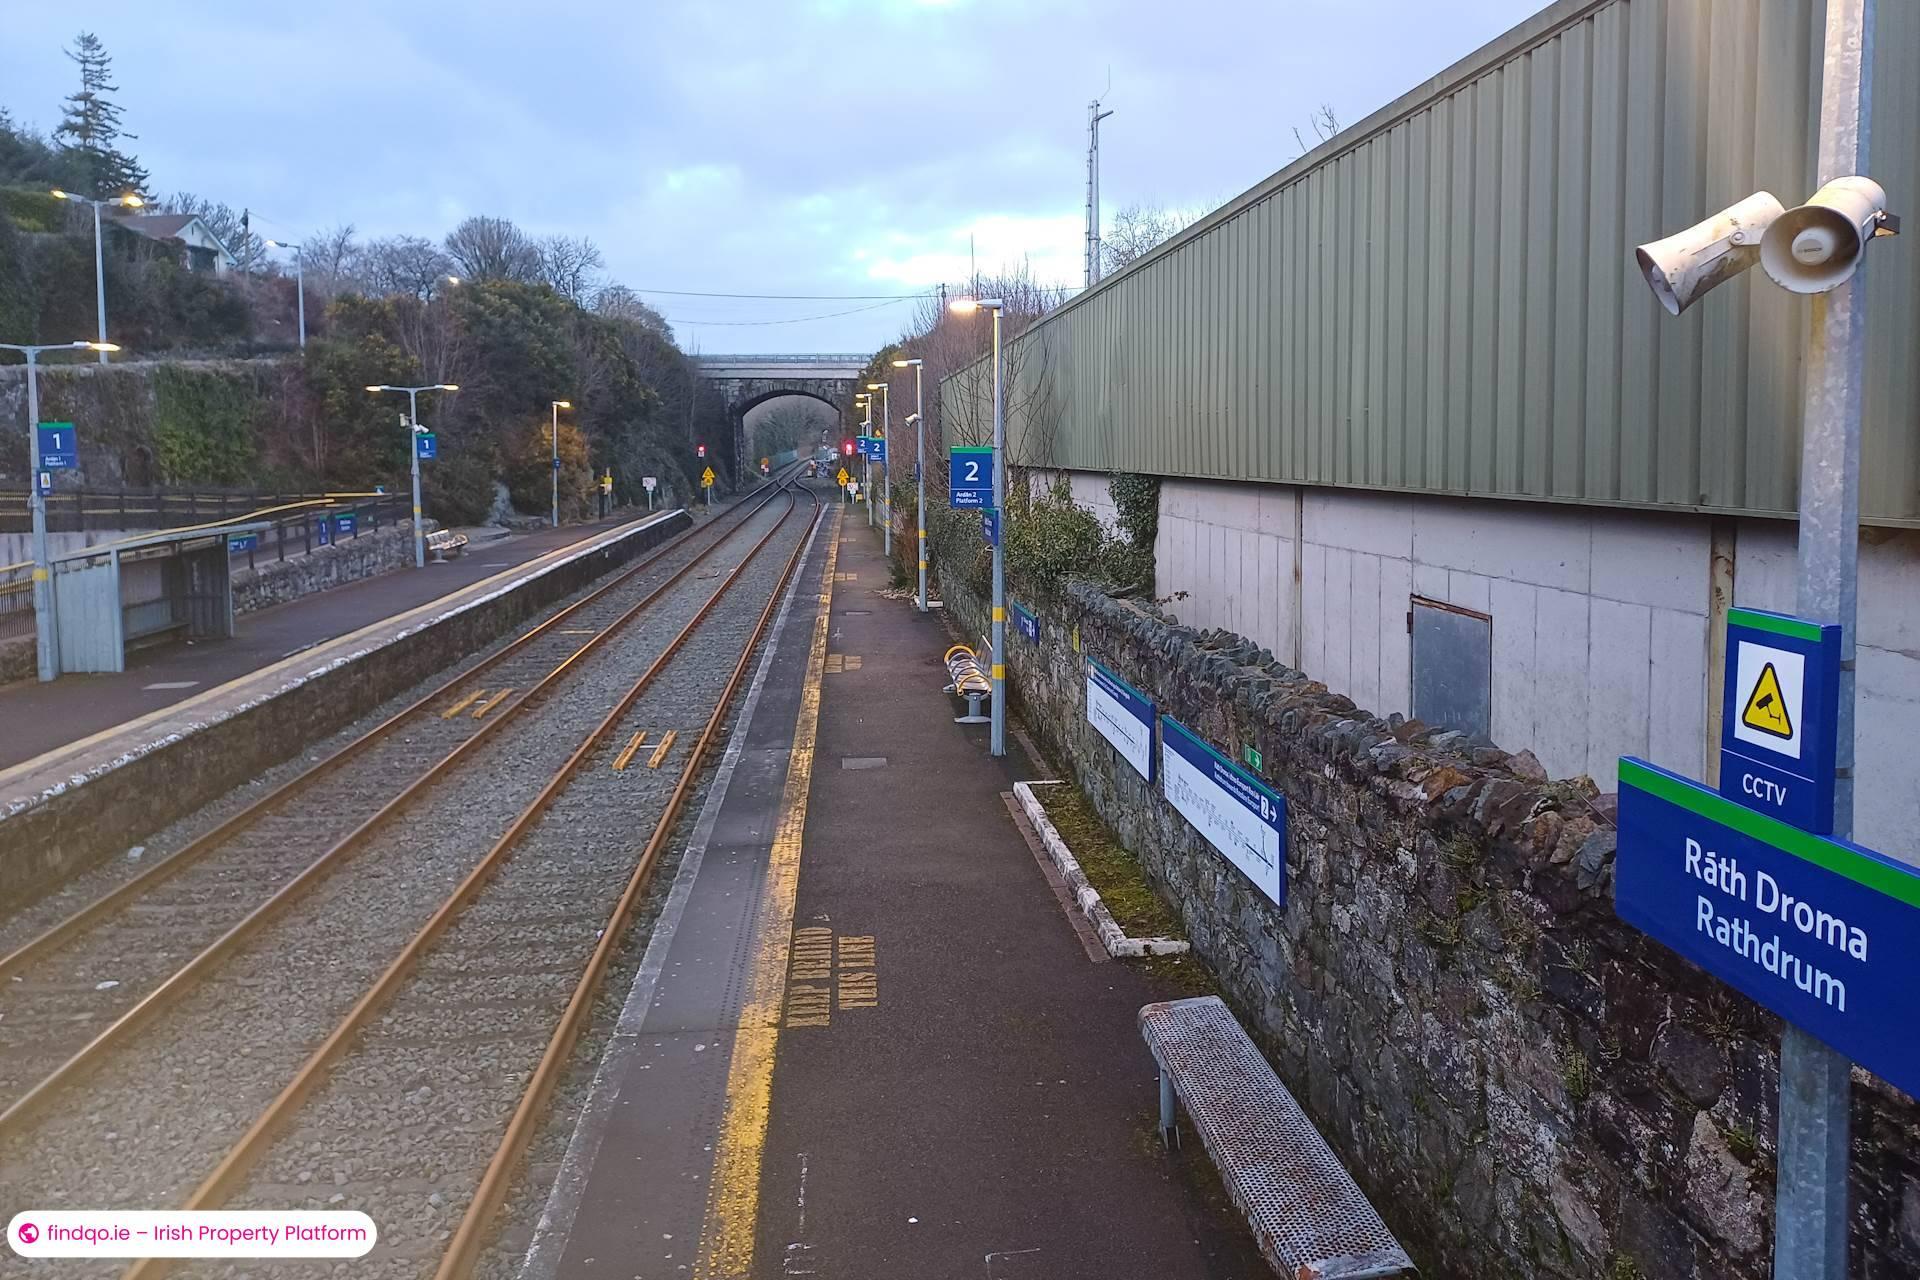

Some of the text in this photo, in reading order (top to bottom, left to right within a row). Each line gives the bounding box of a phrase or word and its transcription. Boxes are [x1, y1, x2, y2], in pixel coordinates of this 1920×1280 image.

[53, 432, 61, 449] 1
[424, 440, 429, 449] 1
[874, 443, 880, 452] 2
[965, 461, 979, 481] 2
[1742, 773, 1787, 806] CCTV
[1685, 837, 1868, 962] Ráth Droma
[1696, 895, 1846, 1013] Rathdrum
